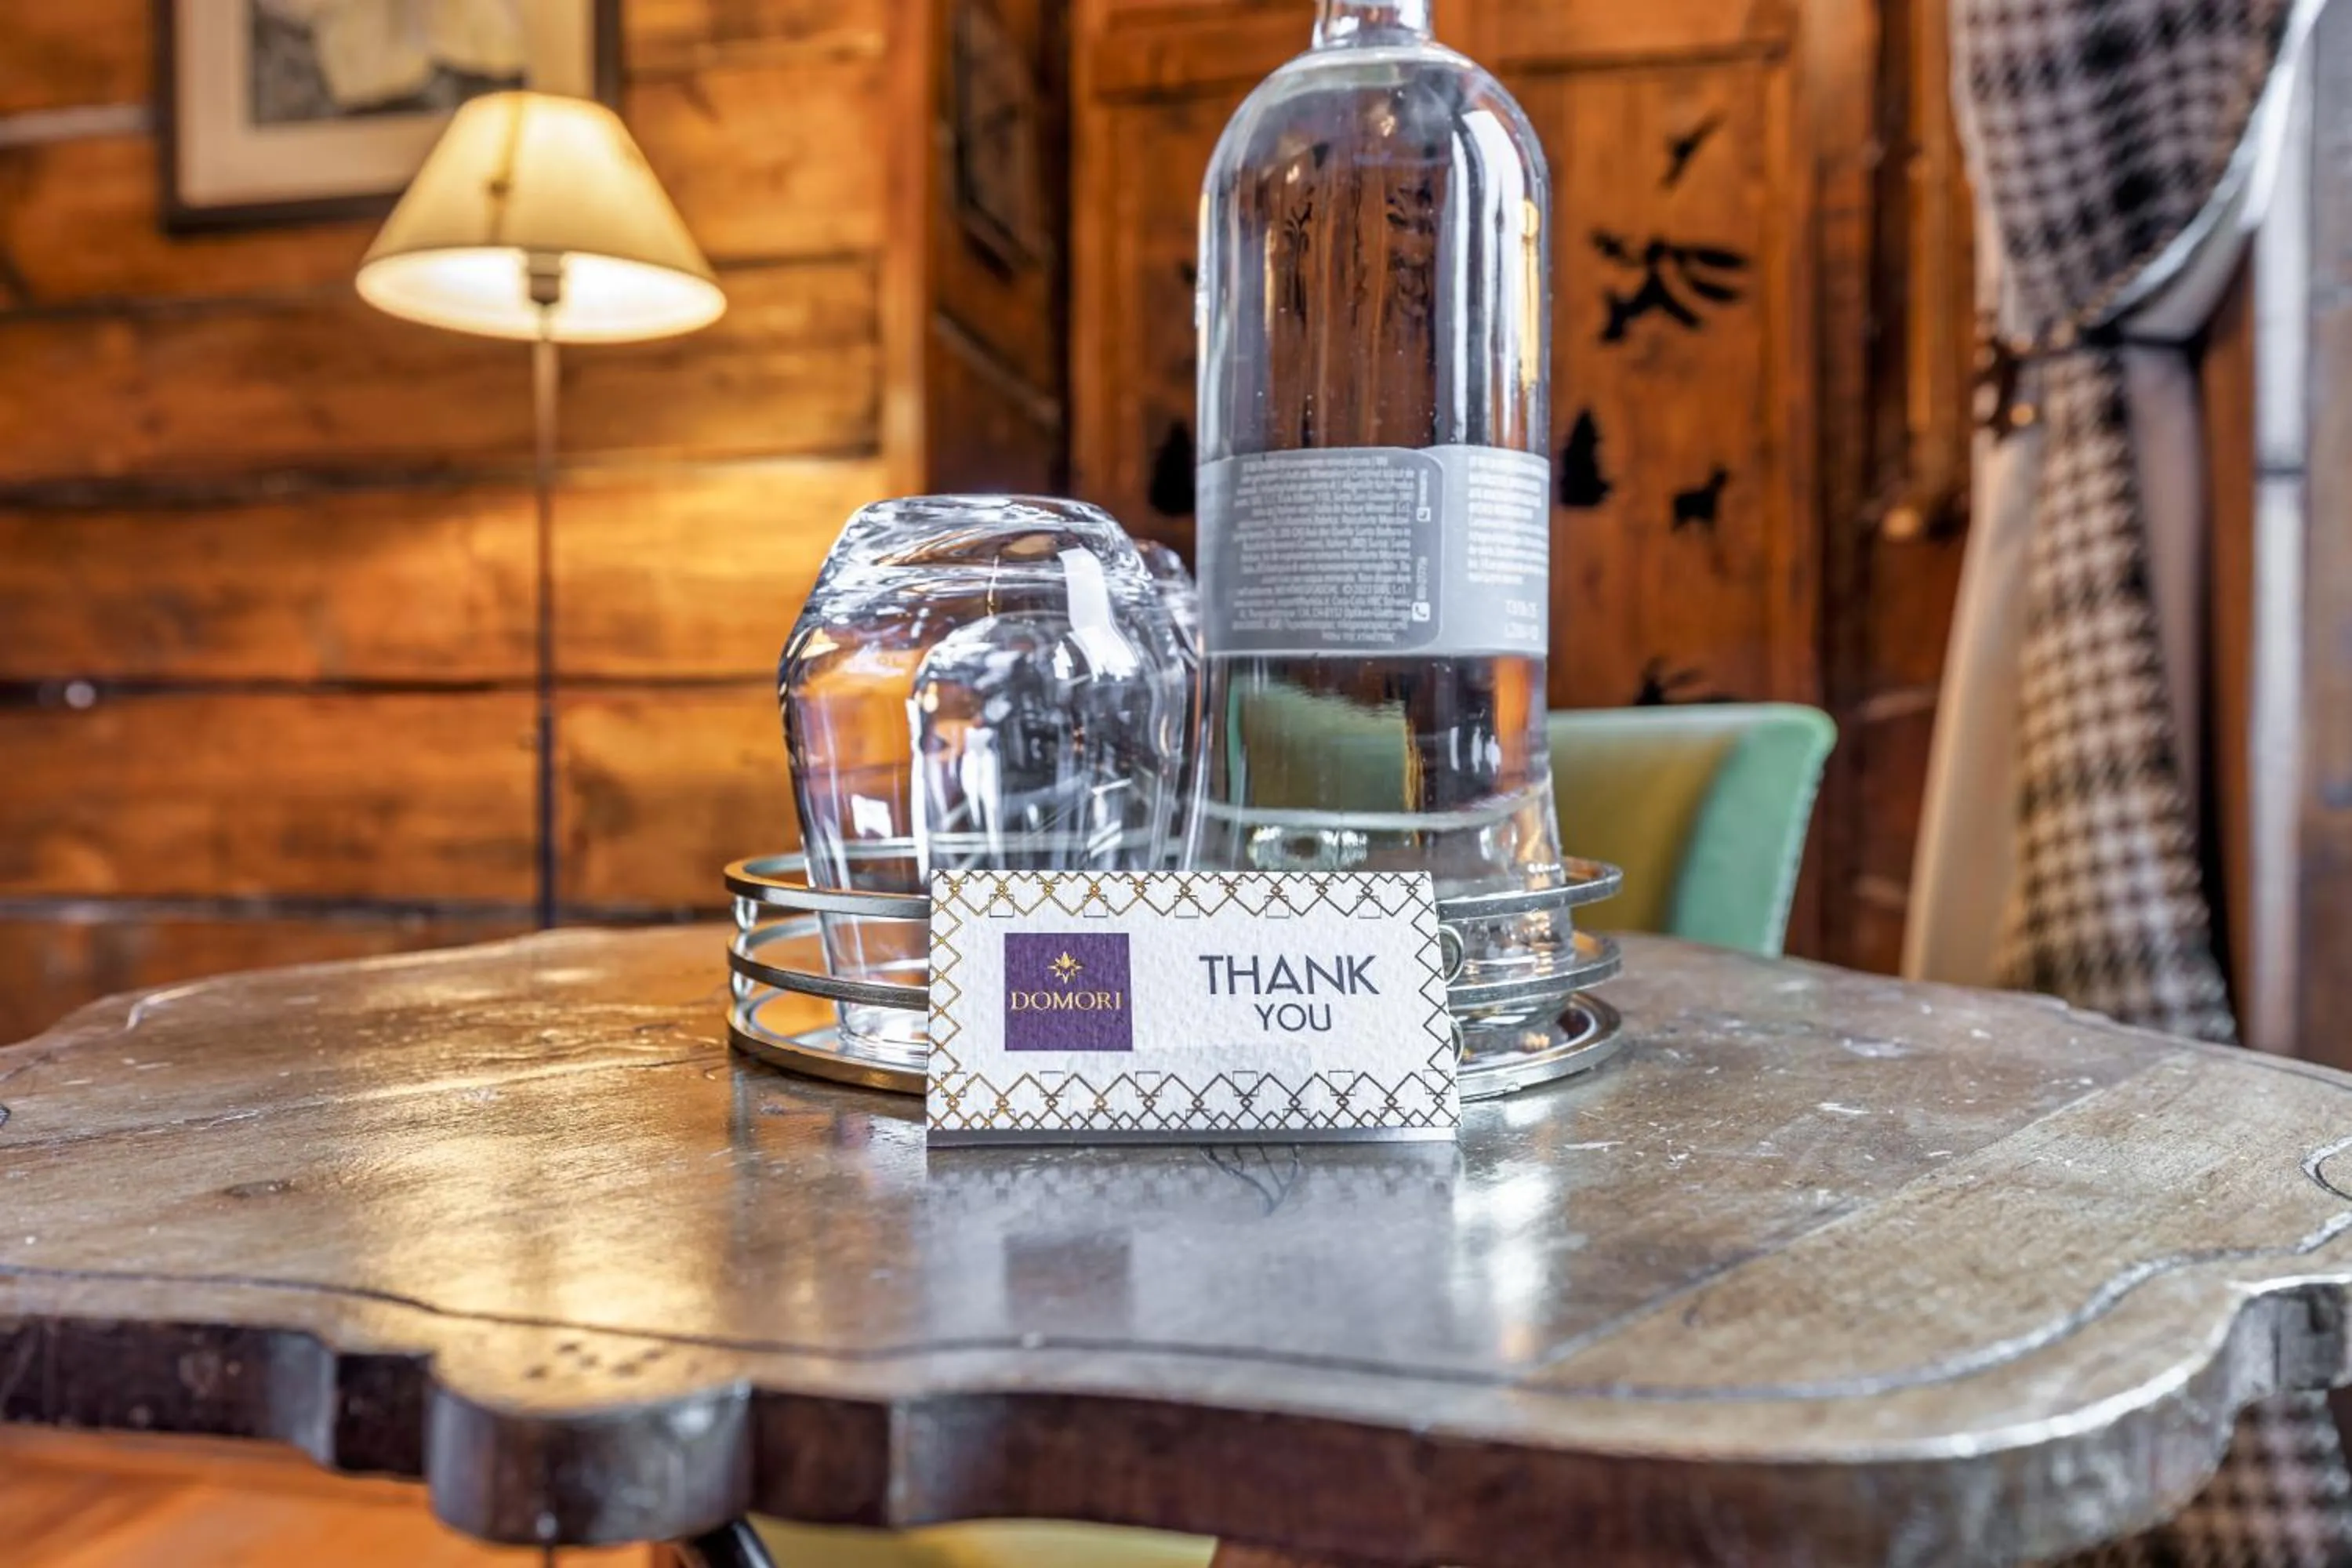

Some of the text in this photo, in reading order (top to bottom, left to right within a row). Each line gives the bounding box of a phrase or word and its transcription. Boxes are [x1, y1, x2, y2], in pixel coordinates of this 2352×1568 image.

[1199, 954, 1381, 996] THANK
[1009, 990, 1123, 1013] DOMORI
[1254, 1003, 1332, 1032] YOU
